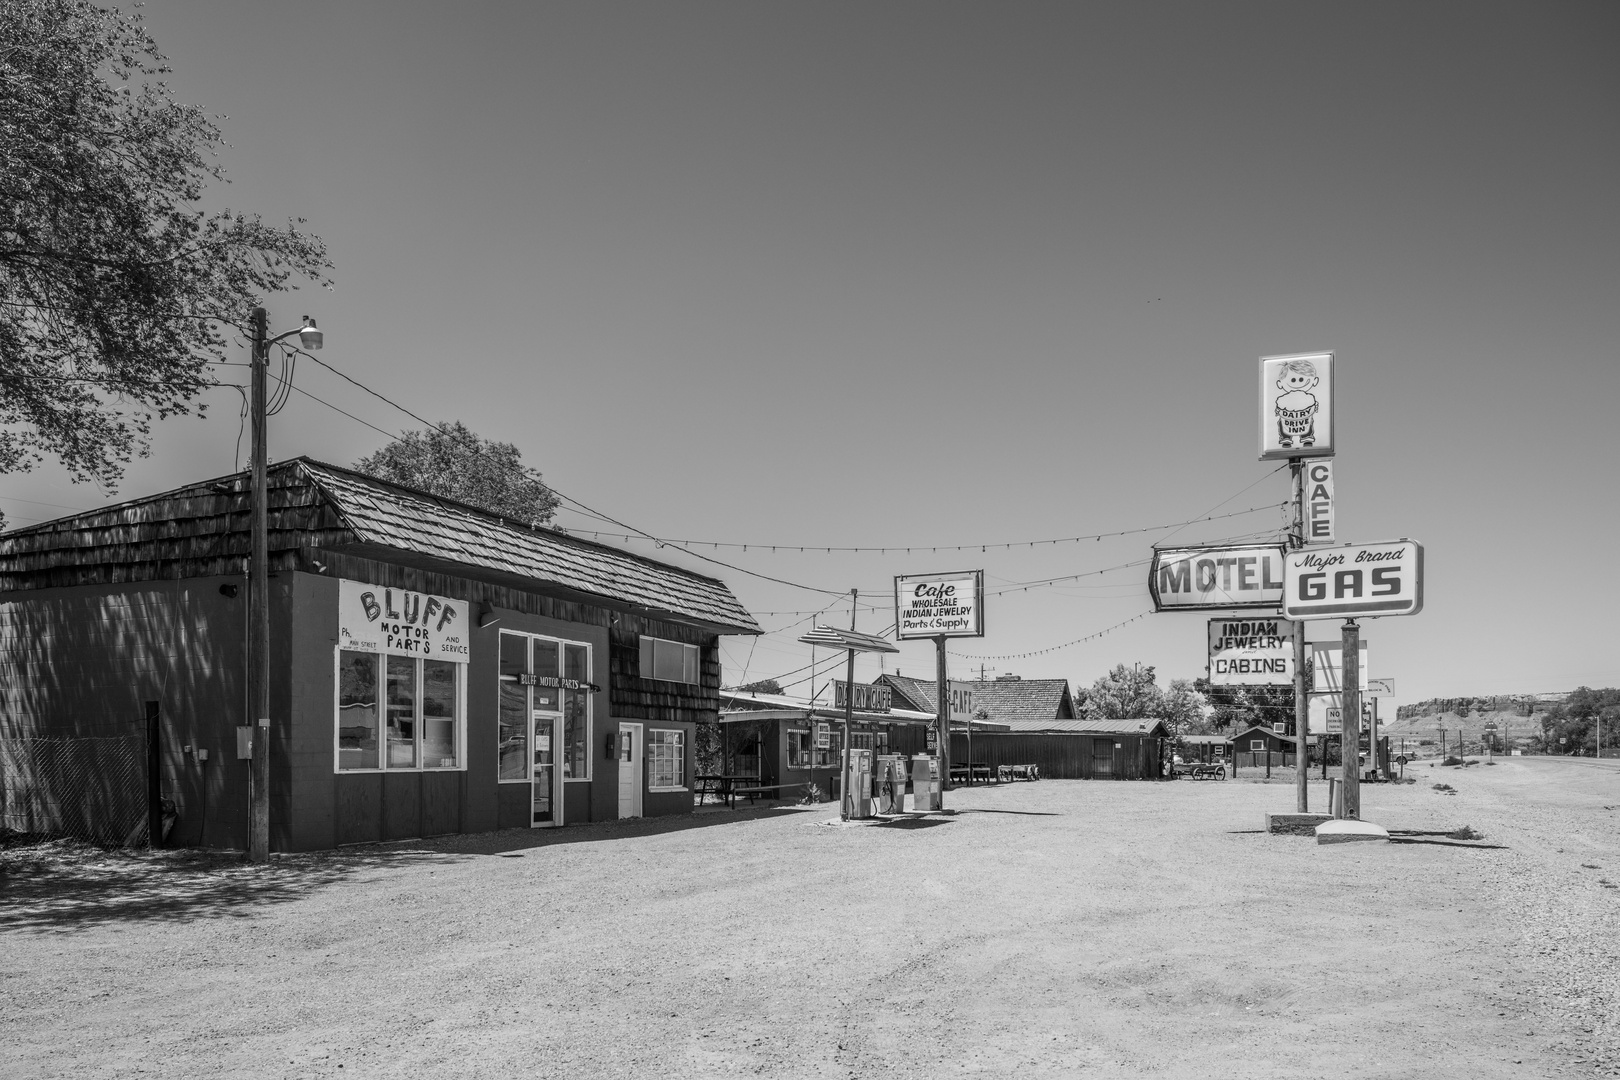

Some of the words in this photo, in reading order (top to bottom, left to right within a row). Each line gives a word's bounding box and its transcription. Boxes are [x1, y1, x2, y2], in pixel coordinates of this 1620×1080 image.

[1282, 408, 1311, 418] DAIRY
[1284, 418, 1309, 427] DRIVE
[1310, 464, 1330, 537] CAFE
[1294, 554, 1346, 572] Major
[1354, 548, 1406, 562] Brand
[1160, 556, 1283, 594] MOTEL
[1298, 566, 1402, 600] GAS
[914, 582, 955, 599] Cafe
[360, 588, 458, 632] BLUFF
[912, 598, 958, 608] WHOLESALE
[902, 608, 932, 618] INDIAN
[933, 606, 972, 617] JEWELRY
[380, 622, 429, 640] MOTOR
[903, 620, 928, 629] Parts
[936, 617, 969, 630] Supply
[1222, 622, 1278, 637] INDIAN
[387, 634, 430, 654] PARTS
[445, 636, 460, 644] AND
[1212, 636, 1287, 651] JEWELRY
[441, 644, 468, 655] SERVICE
[1216, 658, 1286, 674] CABINS
[520, 674, 537, 684] BLUFF
[540, 676, 560, 688] MOTOR
[562, 678, 580, 690] PARTS
[870, 686, 891, 710] CAFE
[953, 689, 972, 714] CAFE
[926, 732, 935, 740] SELF
